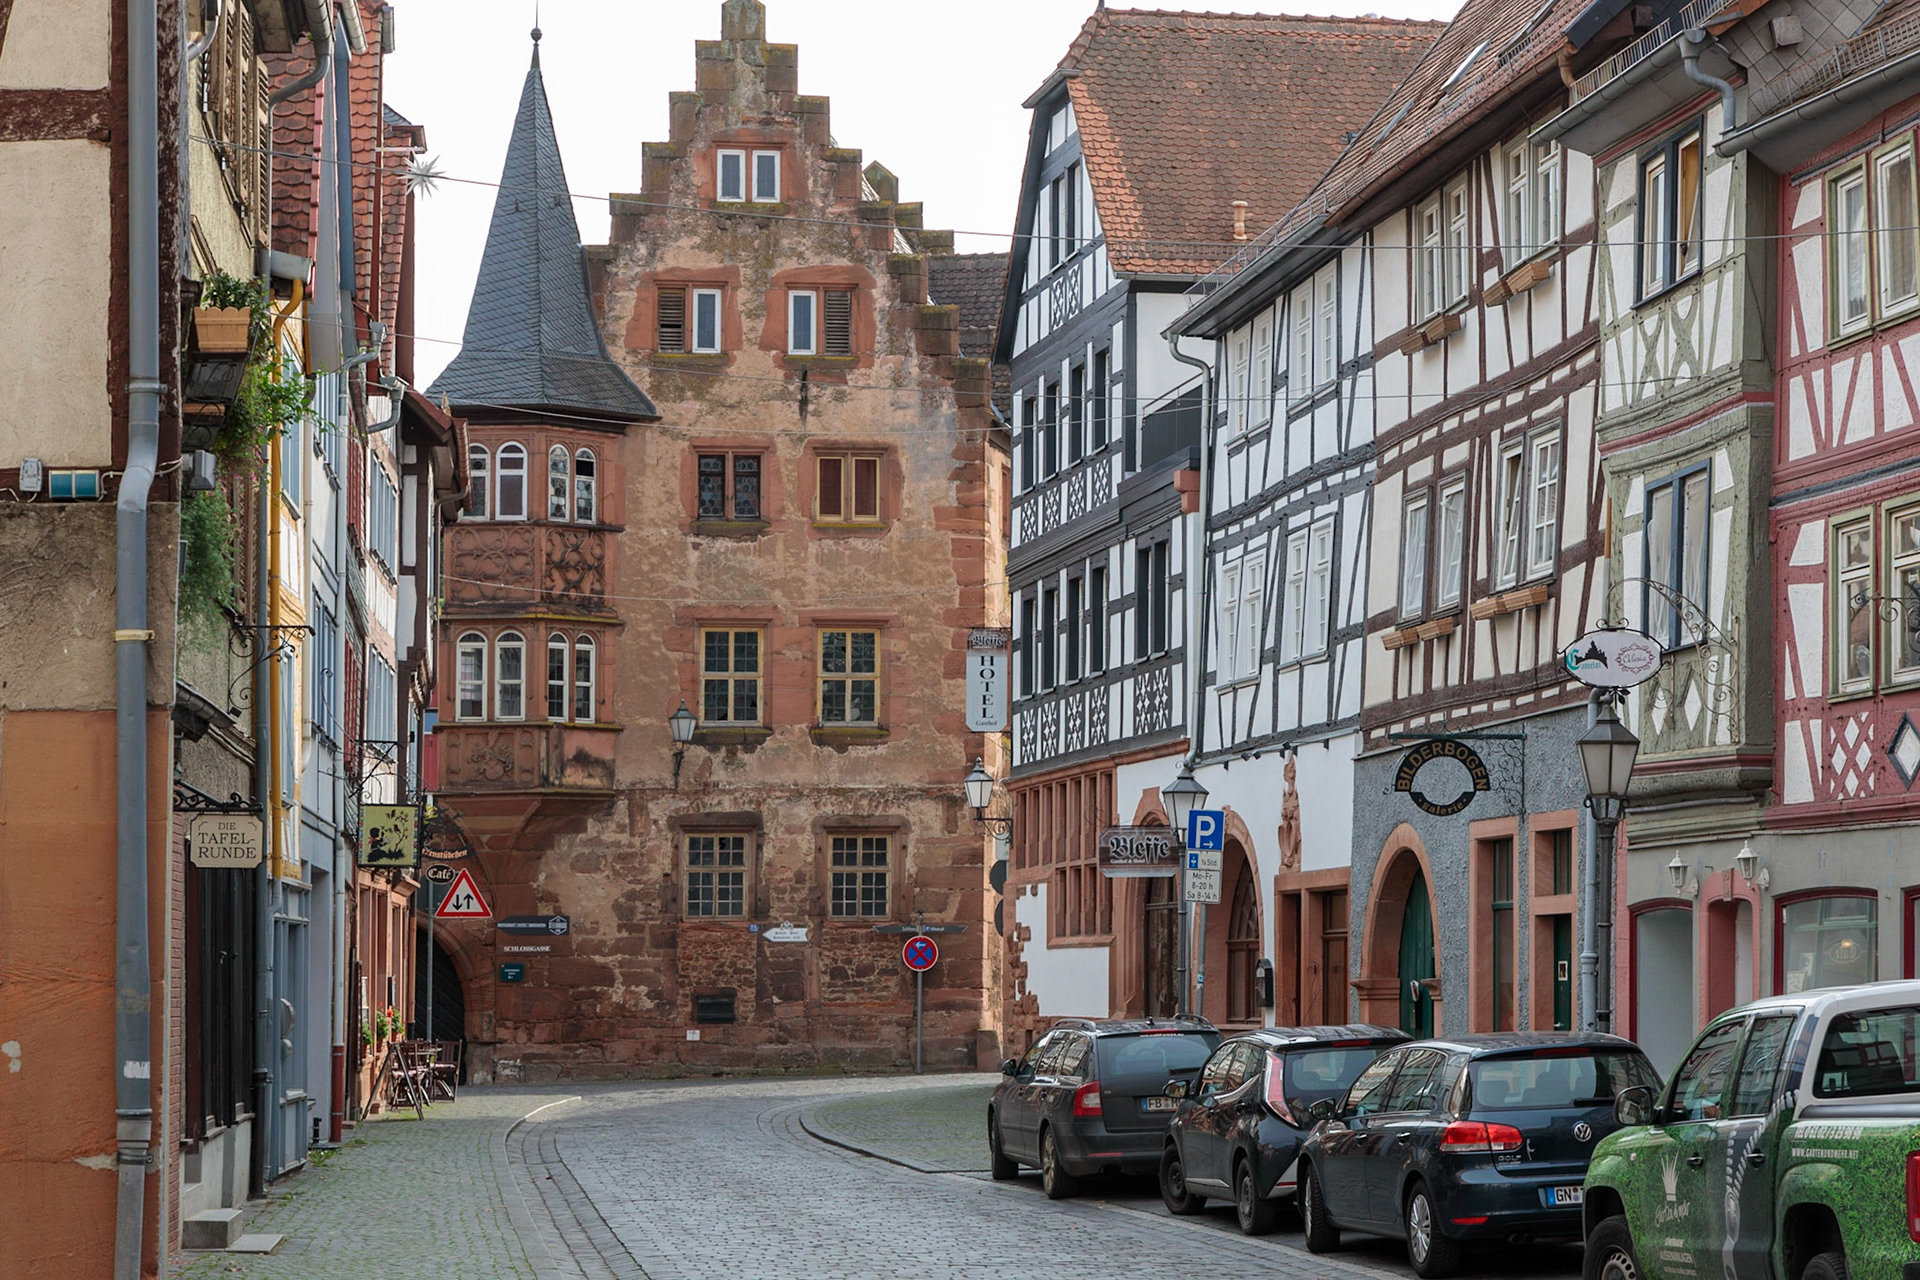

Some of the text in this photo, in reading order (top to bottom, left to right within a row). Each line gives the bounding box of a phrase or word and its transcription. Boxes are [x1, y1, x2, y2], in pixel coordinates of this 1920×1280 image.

[979, 655, 995, 719] HOTEL
[1396, 741, 1488, 791] BILDERBOGEN
[218, 822, 237, 831] DIE
[1195, 815, 1216, 849] P
[197, 832, 256, 845] TAFEL-
[198, 846, 257, 859] RUNDE
[1109, 836, 1170, 864] Bleffe
[428, 867, 452, 880] Café
[1192, 872, 1213, 880] Mo-Fr
[1191, 882, 1207, 890] 8-20
[1187, 891, 1196, 899] Sa
[1148, 1098, 1162, 1109] FB
[1792, 1147, 1859, 1160] WWW.GARTENUNDMEHR.NET
[1555, 1188, 1572, 1203] GN
